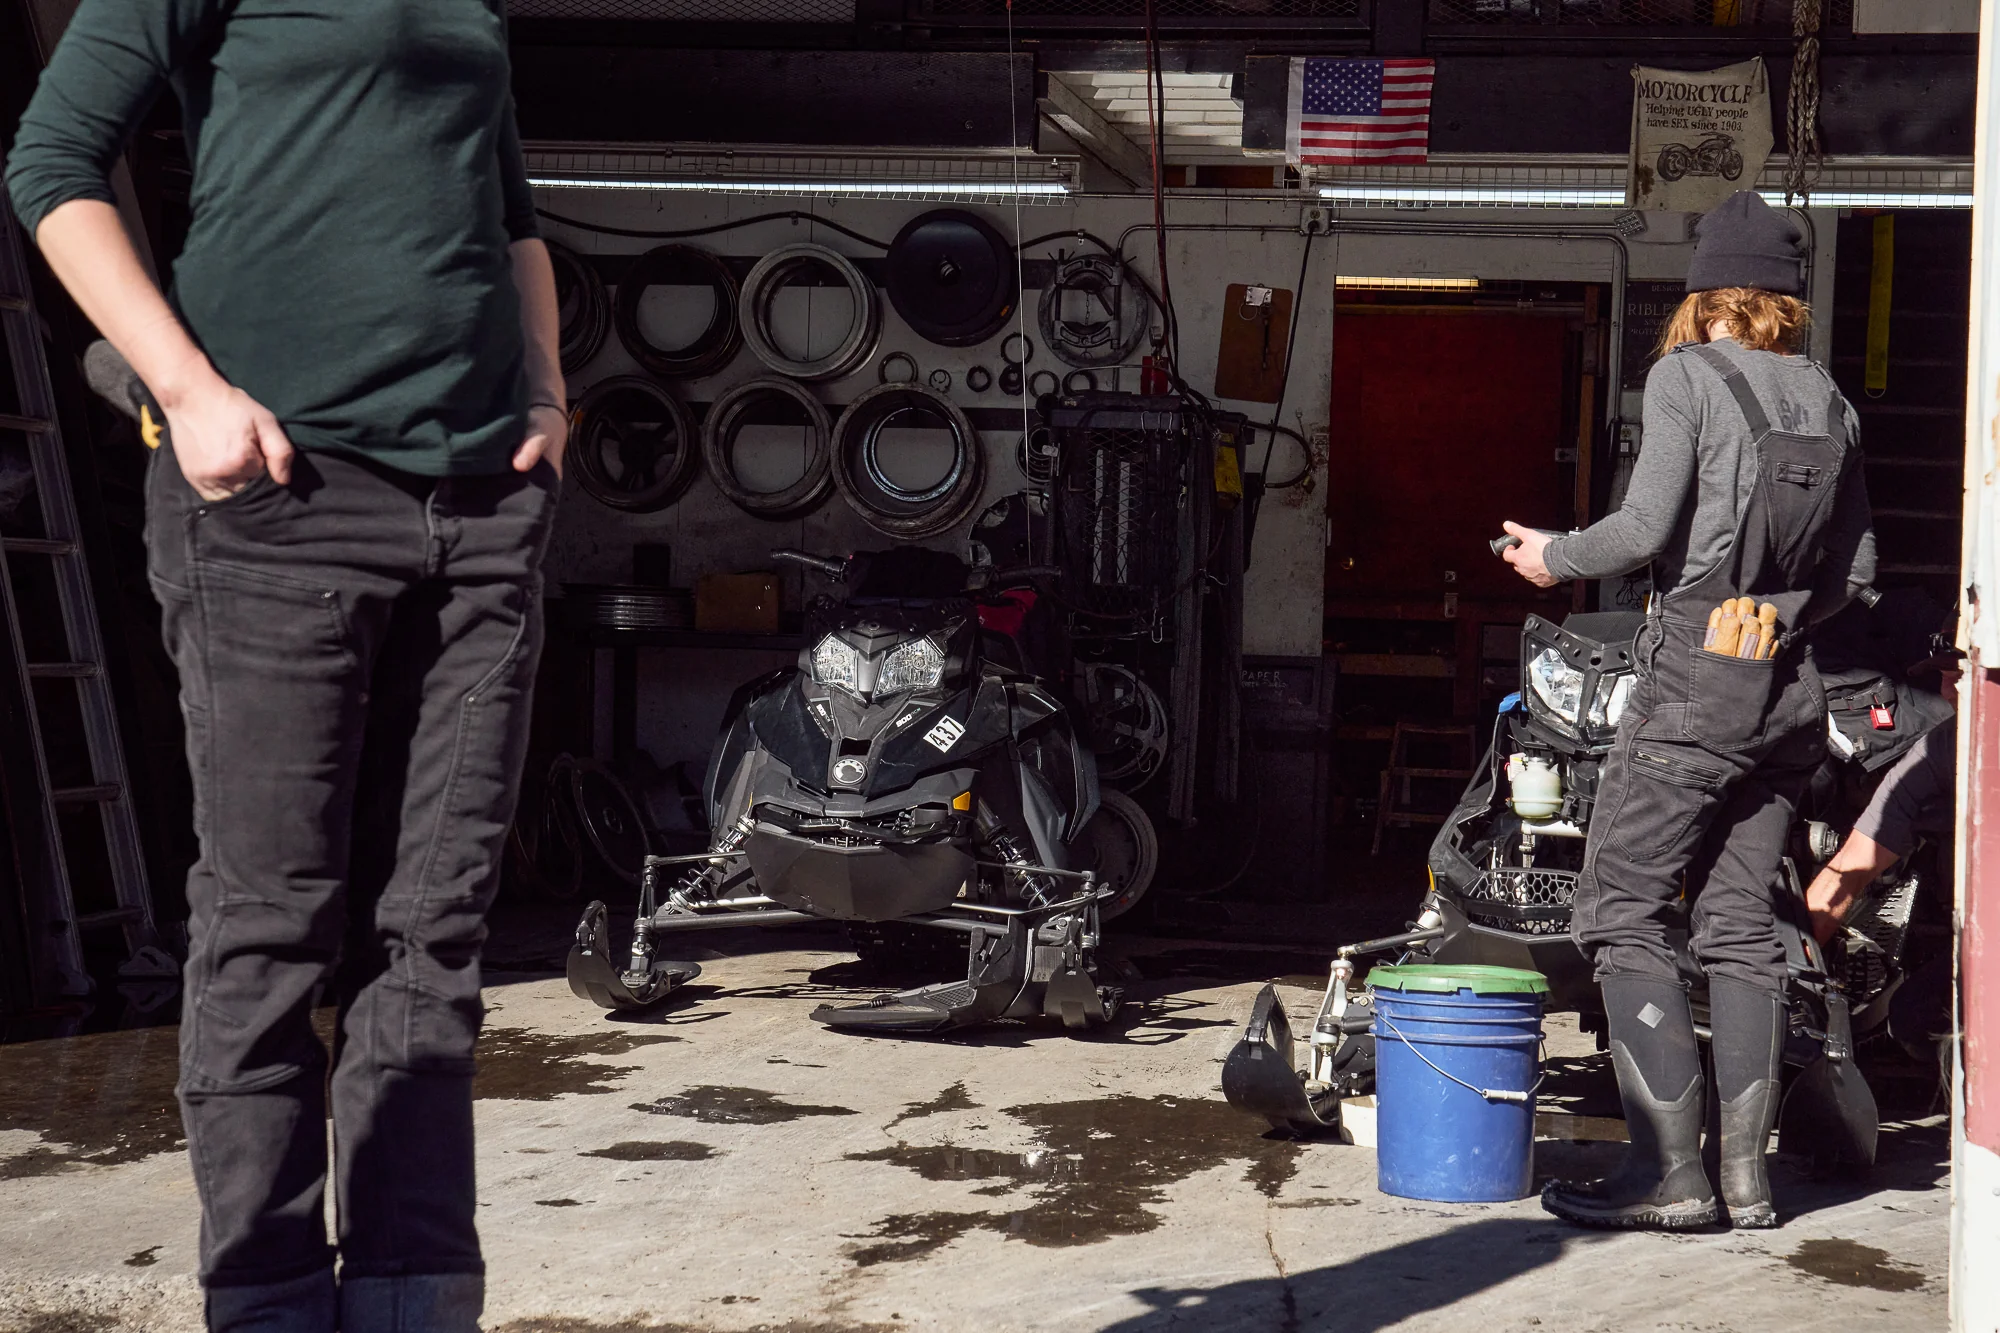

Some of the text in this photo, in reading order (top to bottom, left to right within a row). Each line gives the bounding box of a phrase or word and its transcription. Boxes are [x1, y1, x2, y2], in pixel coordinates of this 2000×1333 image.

[1645, 103, 1749, 120] Helping UGLY people
[1646, 118, 1744, 132] have SEX since 1903.
[1241, 670, 1281, 682] PAPER
[928, 717, 963, 747] 437
